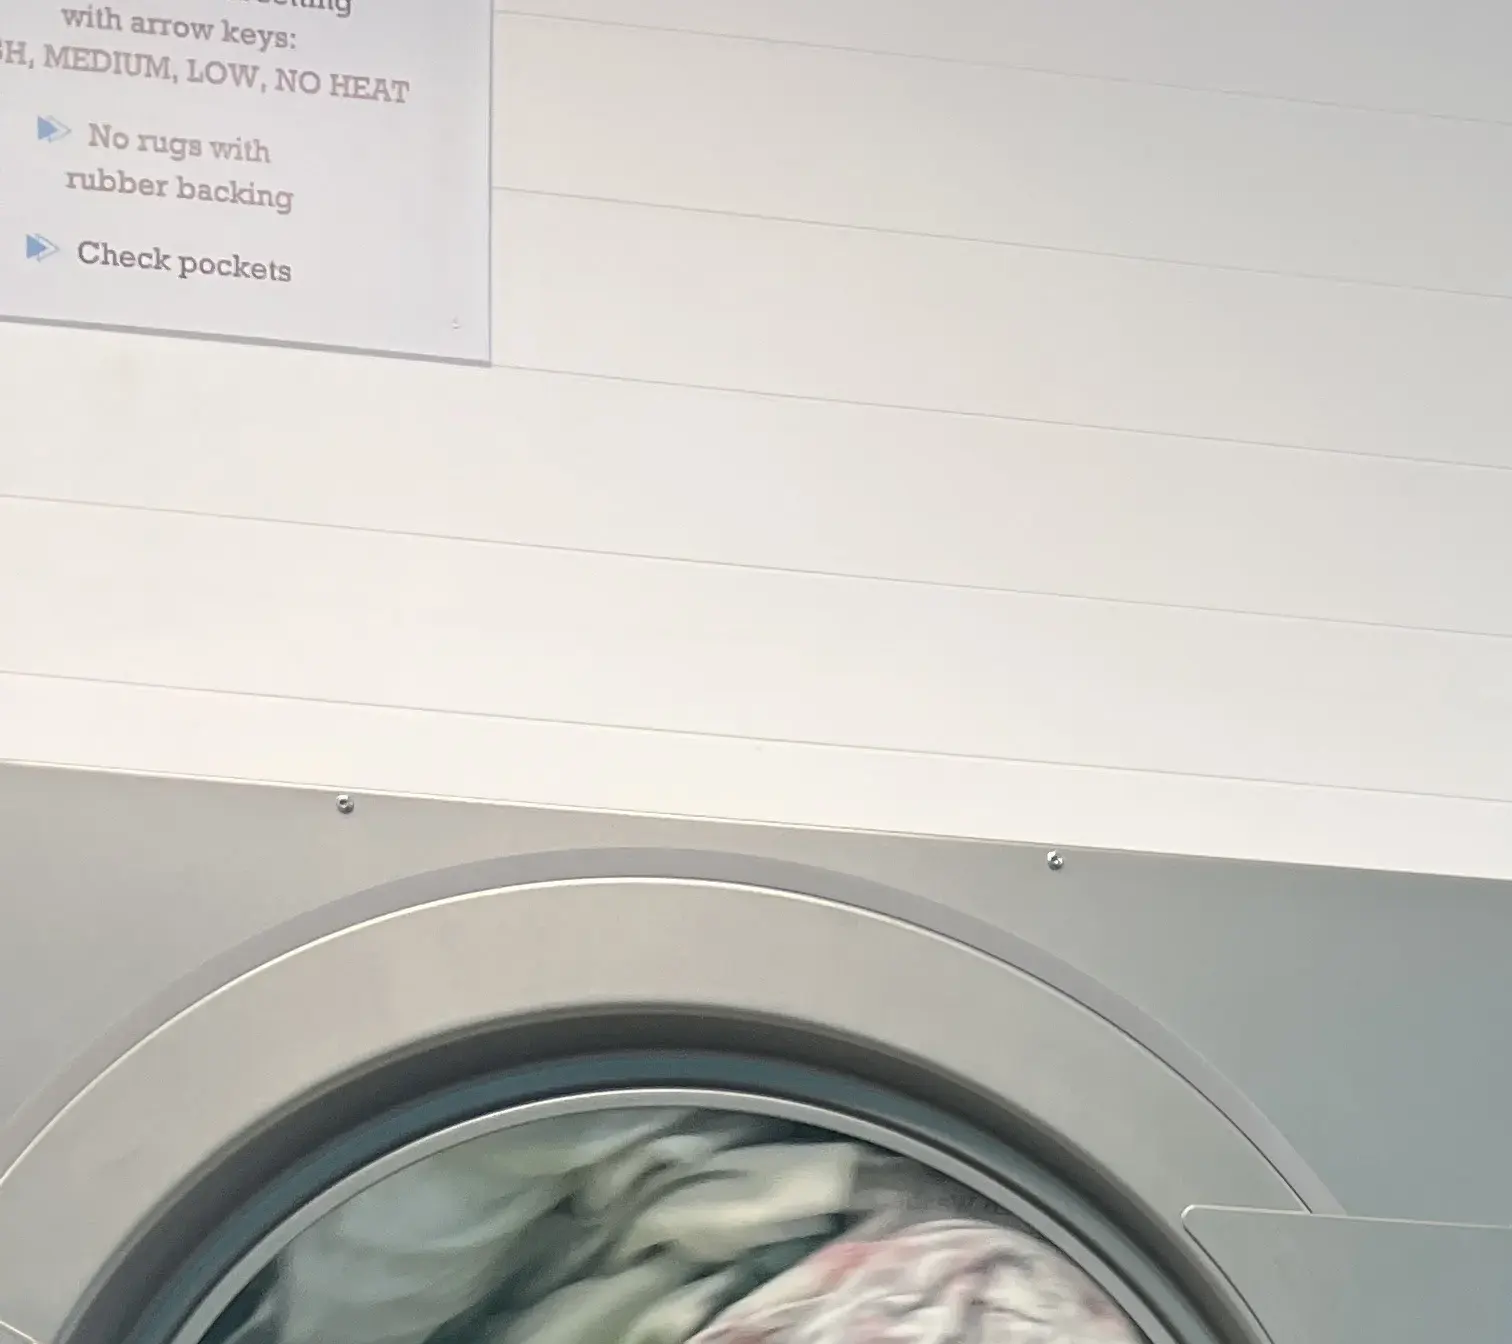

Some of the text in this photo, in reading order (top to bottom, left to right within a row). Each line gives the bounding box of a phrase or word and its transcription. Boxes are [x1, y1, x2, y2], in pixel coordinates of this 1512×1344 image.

[61, 7, 296, 51] with arrow keys:
[43, 43, 178, 82] MEDIUM,
[186, 58, 266, 93] LOW,
[275, 68, 321, 95] NO
[330, 73, 410, 103] HEAT
[88, 122, 270, 164] No rugs with
[66, 168, 293, 214] rubber backing
[77, 240, 292, 282] Check pockets
